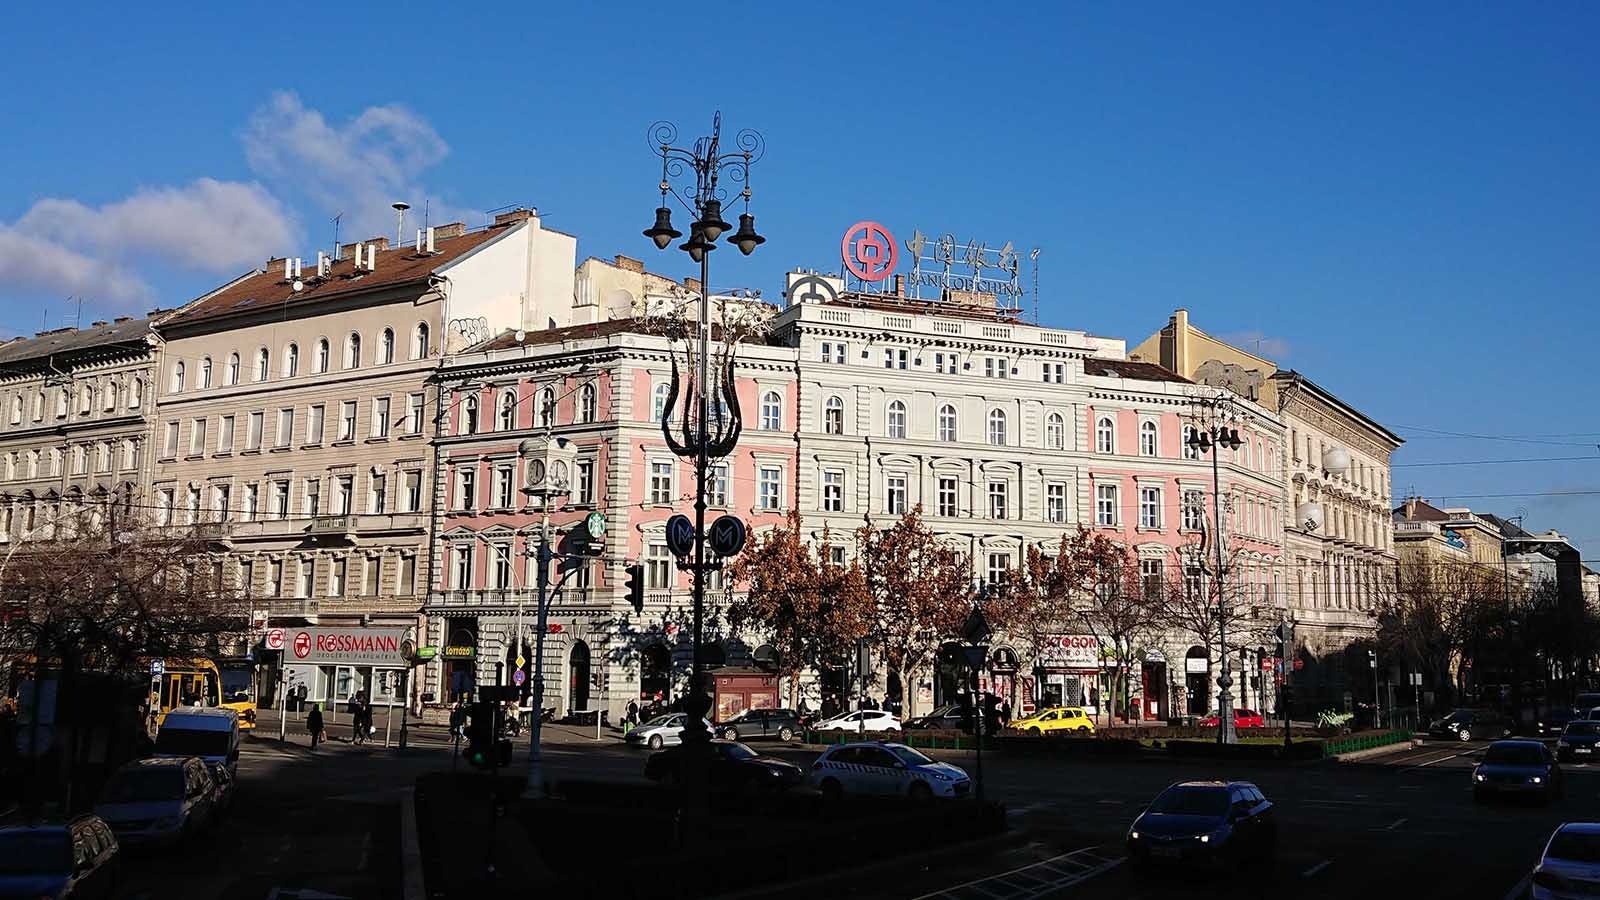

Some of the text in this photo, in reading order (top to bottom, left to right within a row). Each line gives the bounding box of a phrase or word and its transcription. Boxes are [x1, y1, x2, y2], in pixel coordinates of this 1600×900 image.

[908, 272, 949, 289] BANK
[978, 280, 1023, 296] CHINA
[317, 634, 398, 652] ROSSMANN
